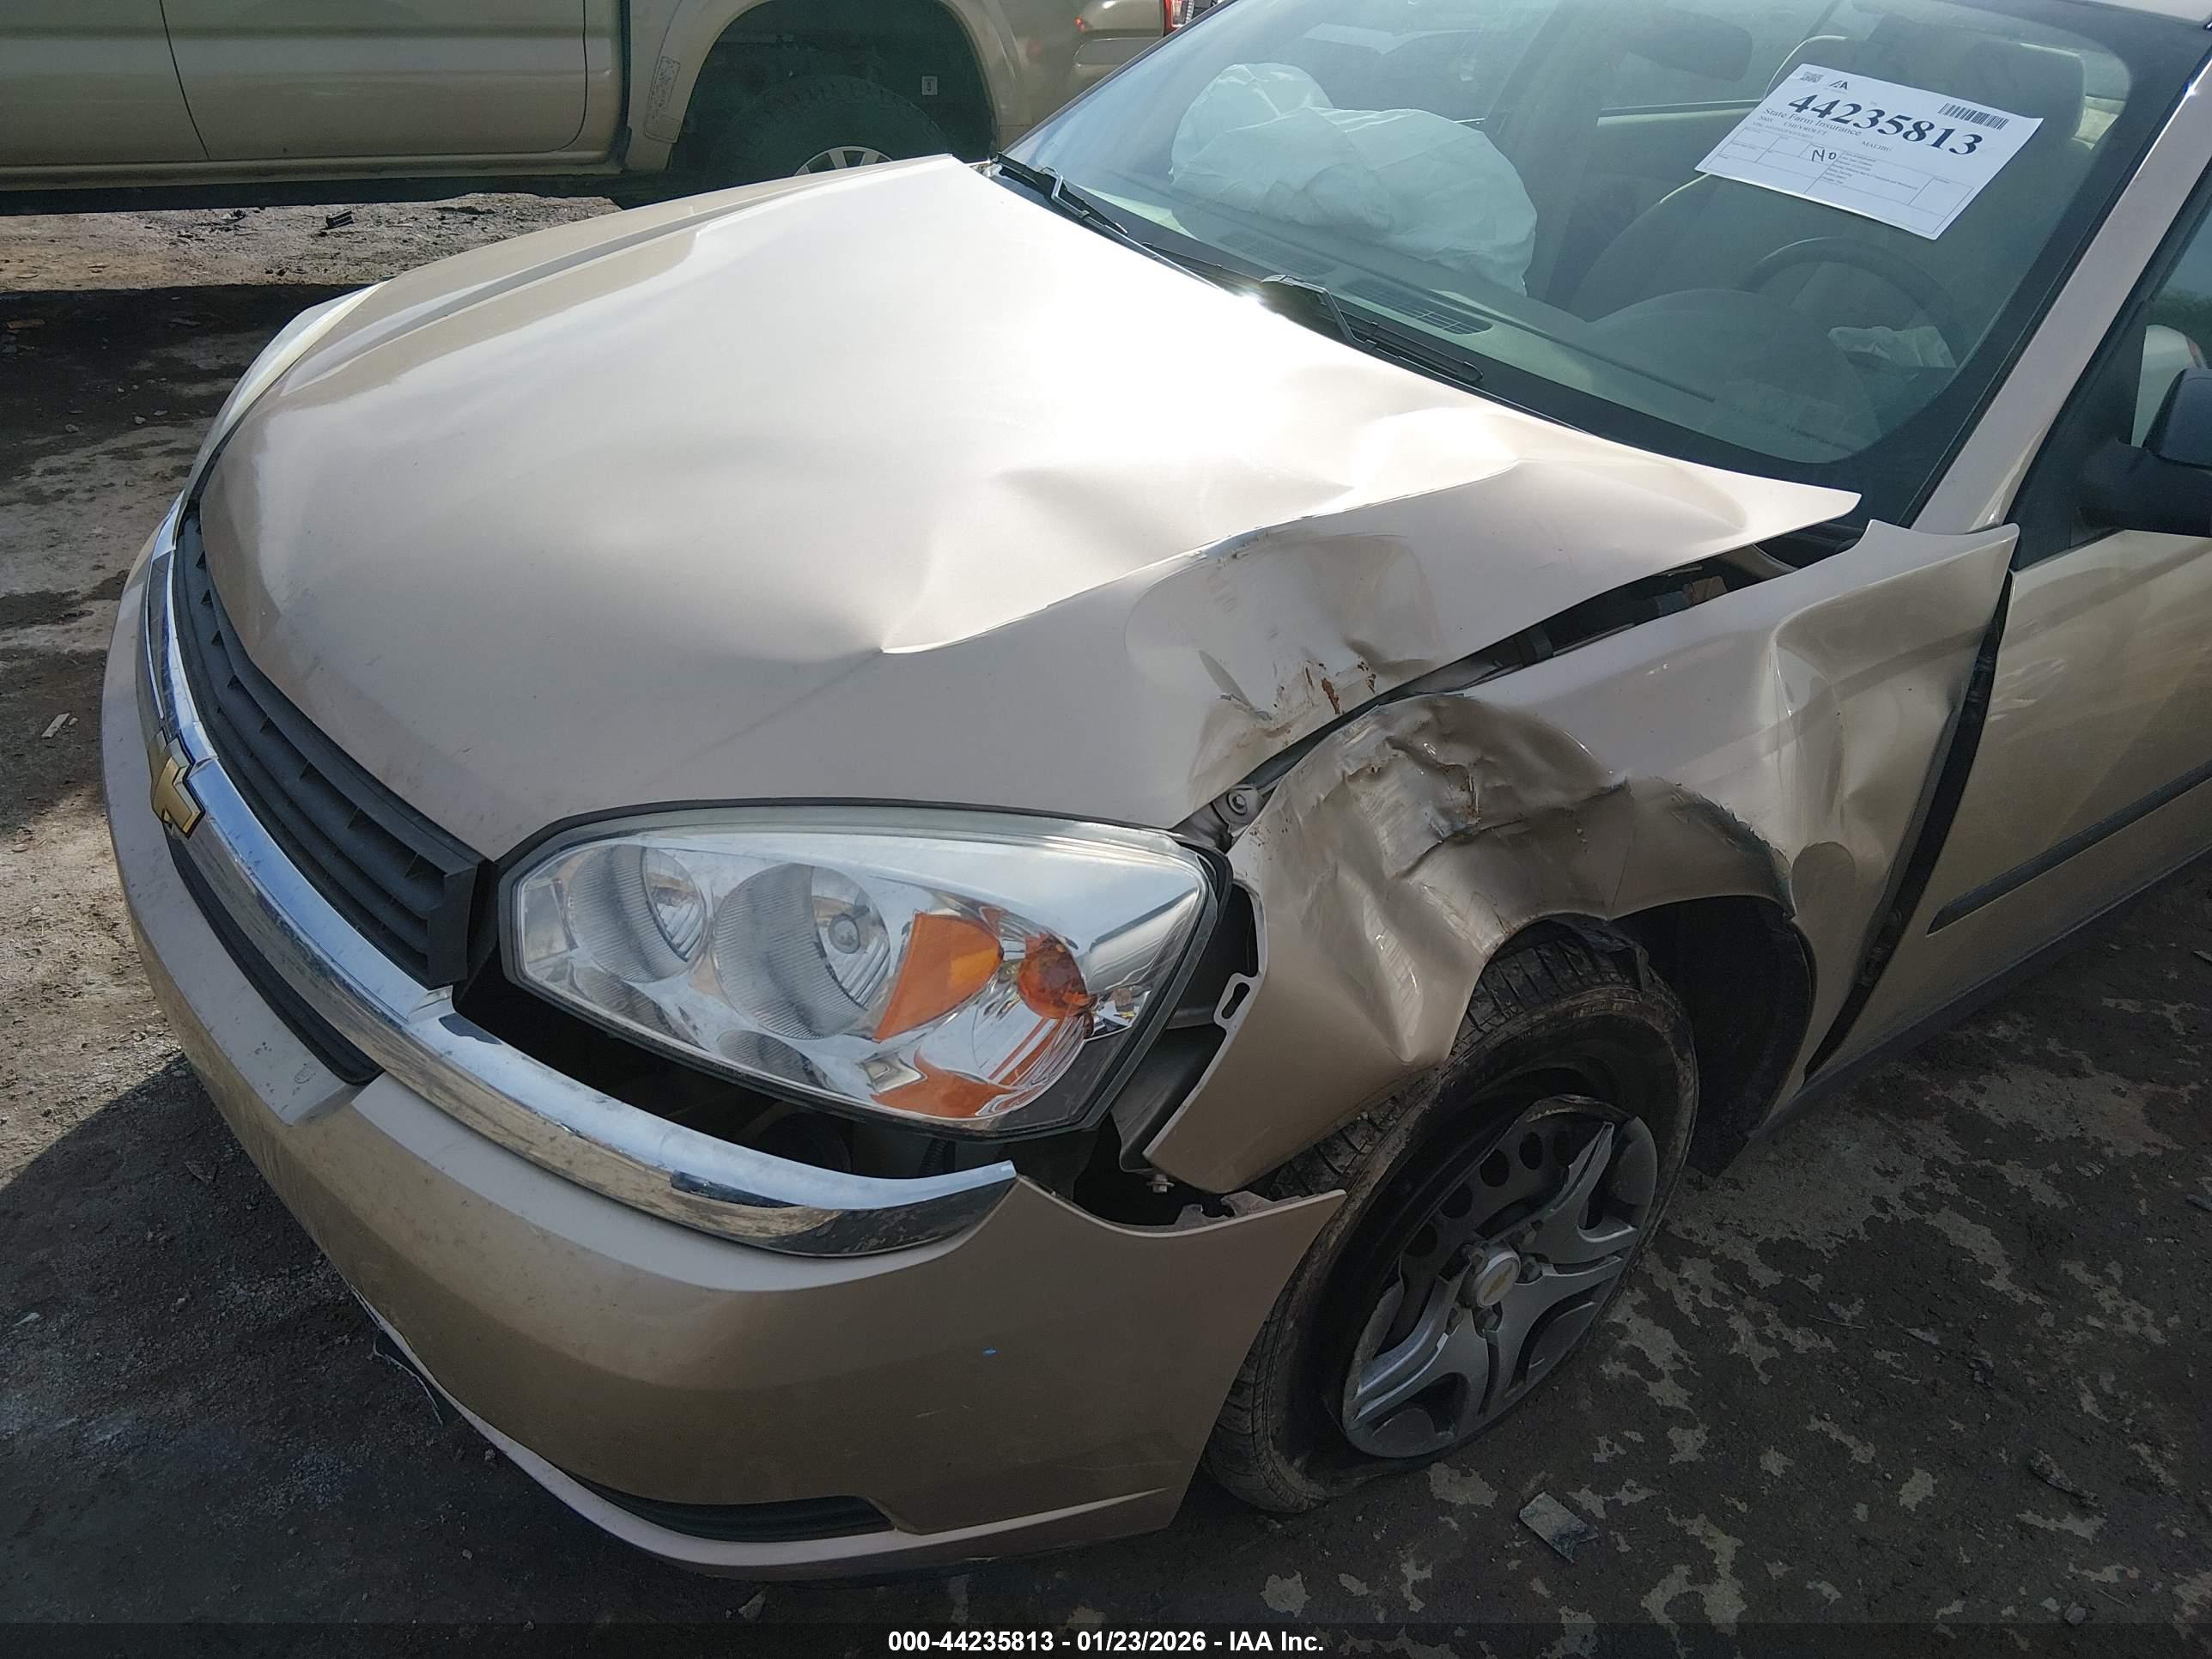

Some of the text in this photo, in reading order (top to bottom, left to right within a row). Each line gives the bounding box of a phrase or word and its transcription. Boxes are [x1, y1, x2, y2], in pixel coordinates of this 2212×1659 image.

[1763, 107, 1787, 118] State
[1788, 112, 1814, 125] Farm
[1815, 119, 1863, 137] Insurance
[1789, 94, 1984, 155] 44235813
